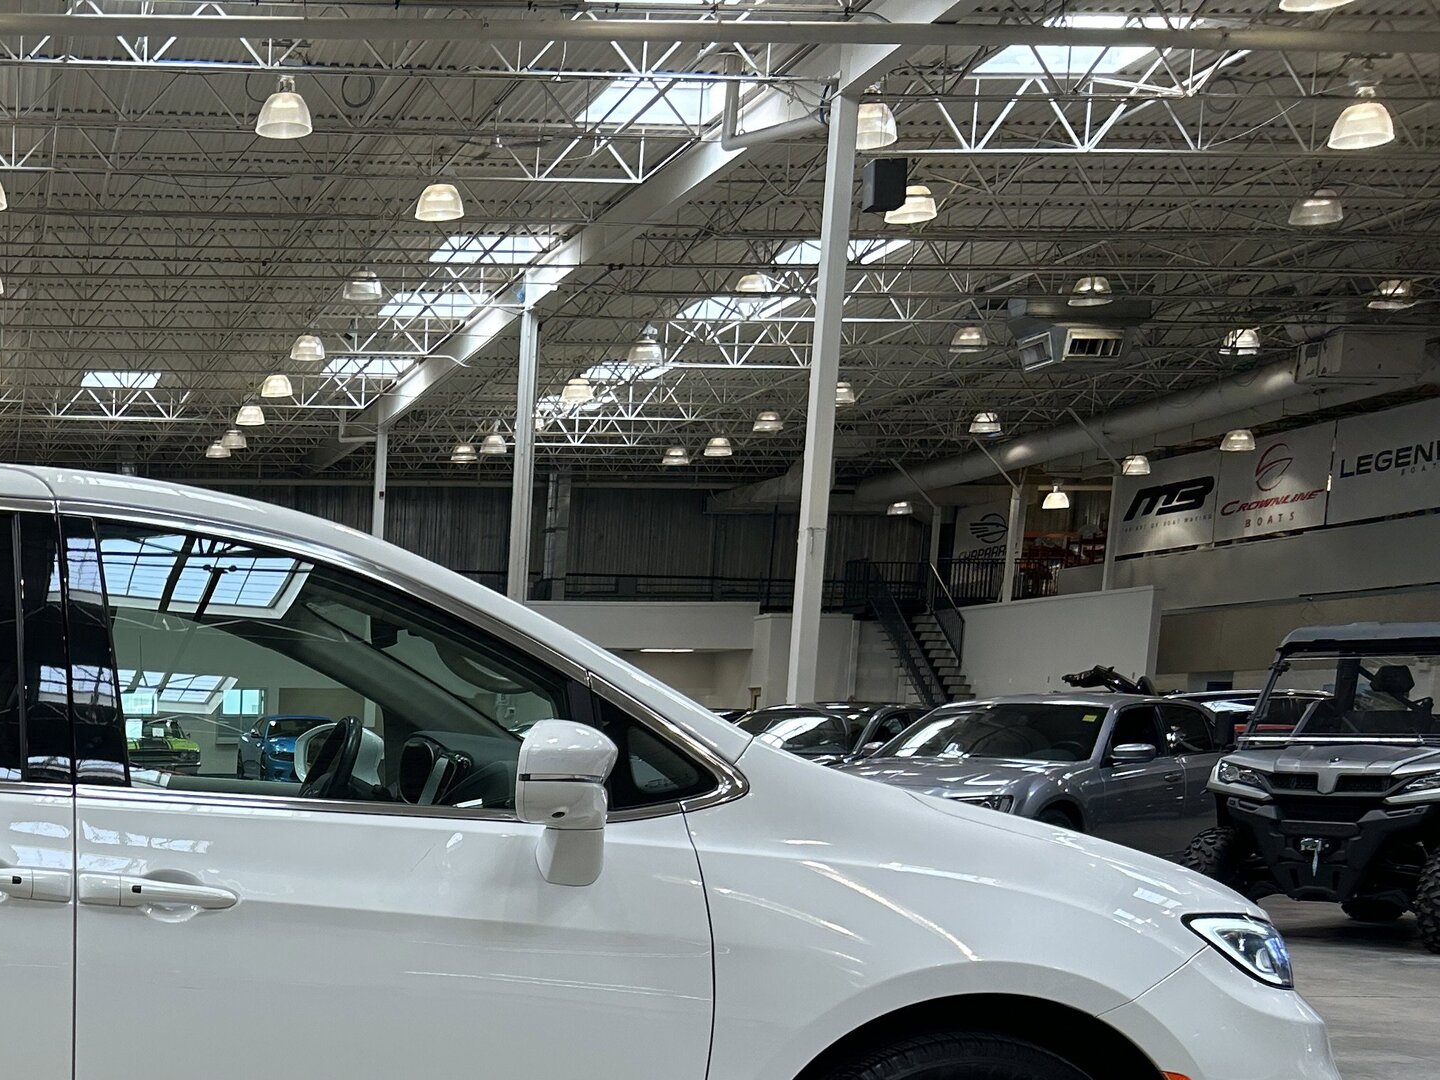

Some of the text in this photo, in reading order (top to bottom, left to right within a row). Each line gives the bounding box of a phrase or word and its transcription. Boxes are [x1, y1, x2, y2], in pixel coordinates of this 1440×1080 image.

[1340, 439, 1440, 478] LEGEN
[1220, 488, 1325, 516] CROWNLINE
[1244, 511, 1295, 528] BOATS
